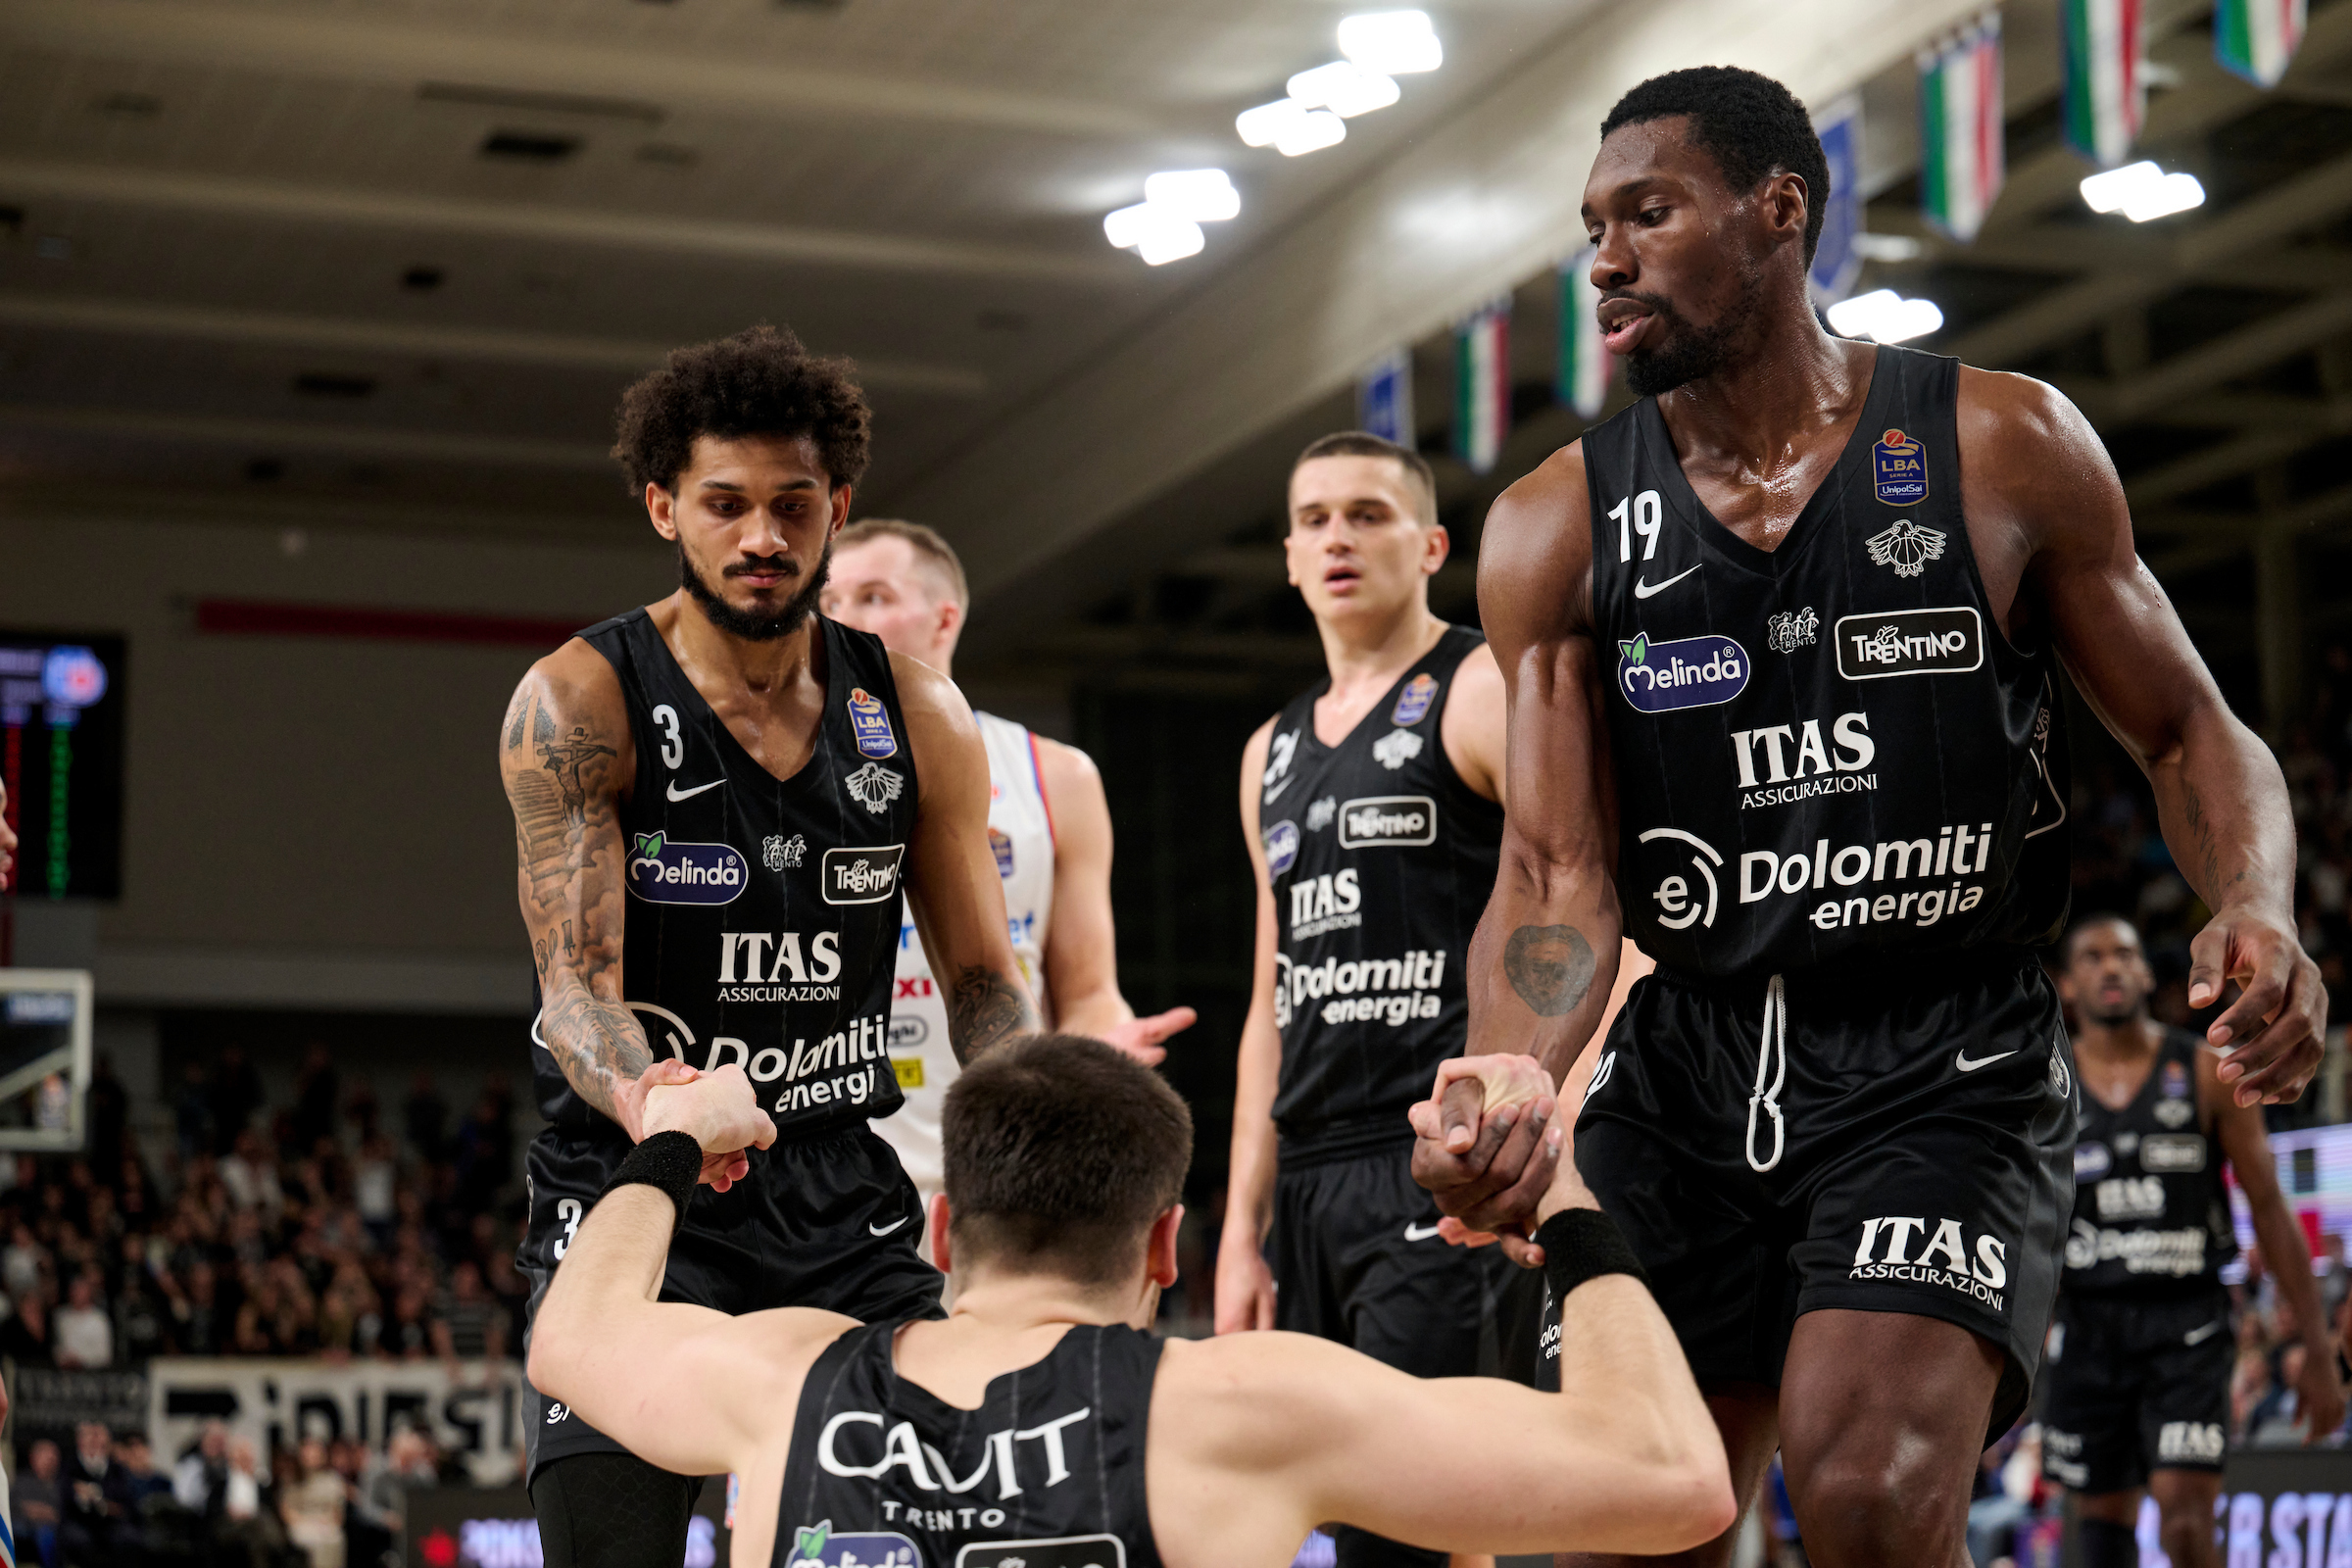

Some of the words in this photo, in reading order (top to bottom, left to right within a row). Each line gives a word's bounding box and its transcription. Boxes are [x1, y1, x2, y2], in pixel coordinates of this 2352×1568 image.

[1881, 458, 1921, 471] LBA
[1883, 484, 1923, 496] UnipolSai
[1607, 489, 1663, 564] 19
[1779, 636, 1817, 649] TRENTO
[1850, 628, 1966, 665] TRENTINO
[1625, 650, 1741, 691] Melinda
[652, 704, 683, 770] 3
[857, 715, 887, 729] LBA
[861, 738, 893, 751] UnipolSai
[1729, 711, 1876, 788] ITAS
[1740, 772, 1879, 809] ASSICURAZIONI
[630, 854, 740, 886] Melinda
[771, 859, 804, 869] TRENTO
[1739, 822, 1992, 905] Dolomiti
[1289, 868, 1363, 927] ITAS
[1808, 882, 1984, 930] energia
[718, 931, 841, 984] ITAS
[1292, 950, 1447, 1007] Dolomiti
[717, 985, 841, 1003] ASSICURAZIONI
[1320, 991, 1443, 1027] energia
[703, 1015, 888, 1083] Dolomiti
[775, 1065, 875, 1114] energi
[554, 1199, 592, 1261] 3
[1851, 1215, 2007, 1291] ITAS
[1848, 1263, 2004, 1313] ASSICURAZIONI
[816, 1406, 1092, 1501] CAVIT
[881, 1499, 1005, 1533] TRENTO
